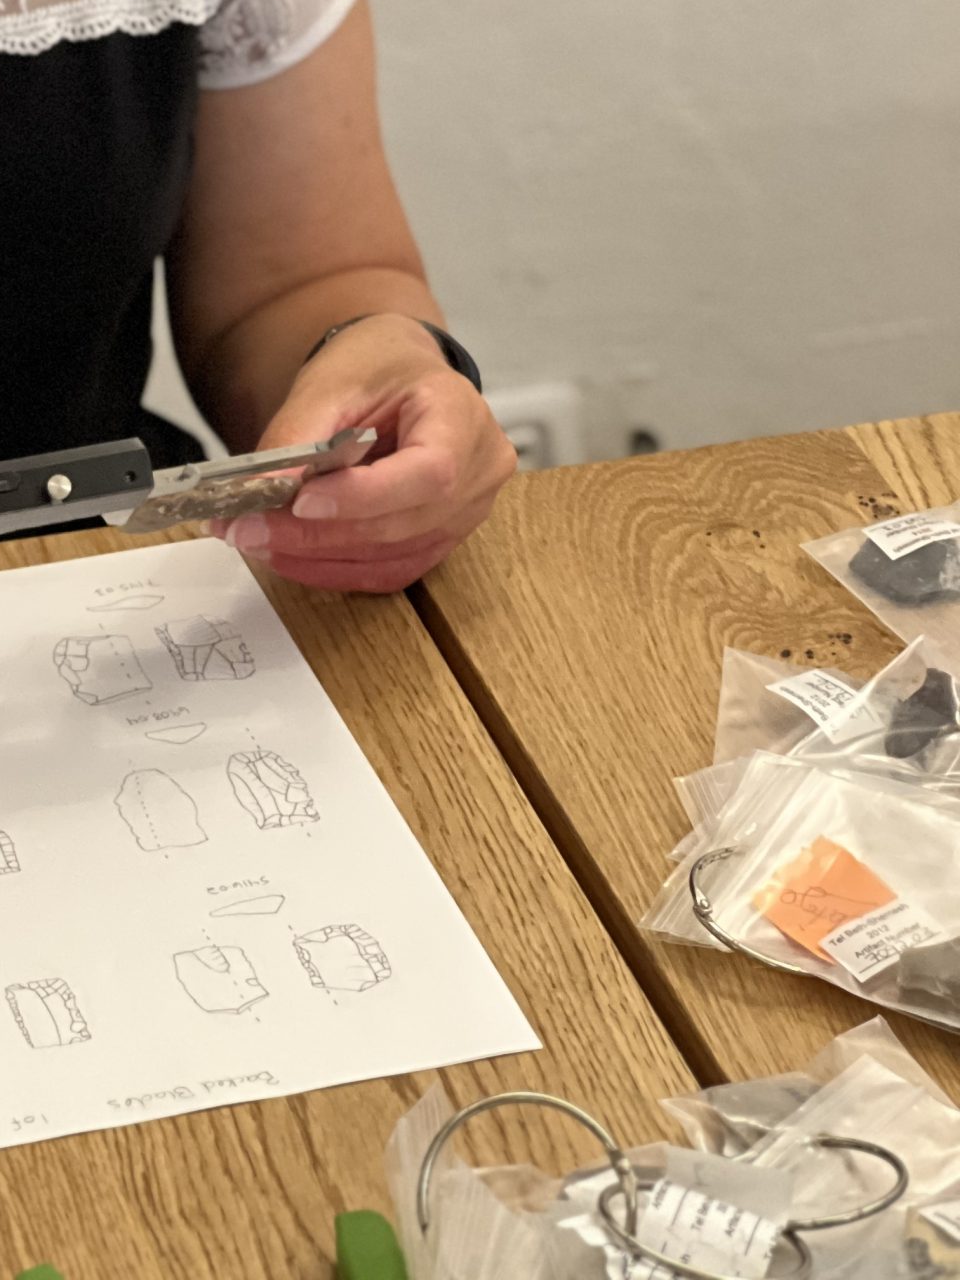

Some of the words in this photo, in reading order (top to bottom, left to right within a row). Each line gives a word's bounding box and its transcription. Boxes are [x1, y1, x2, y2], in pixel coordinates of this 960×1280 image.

[866, 924, 889, 939] 2012
[200, 1070, 280, 1093] Backed
[106, 1085, 196, 1111] Blades
